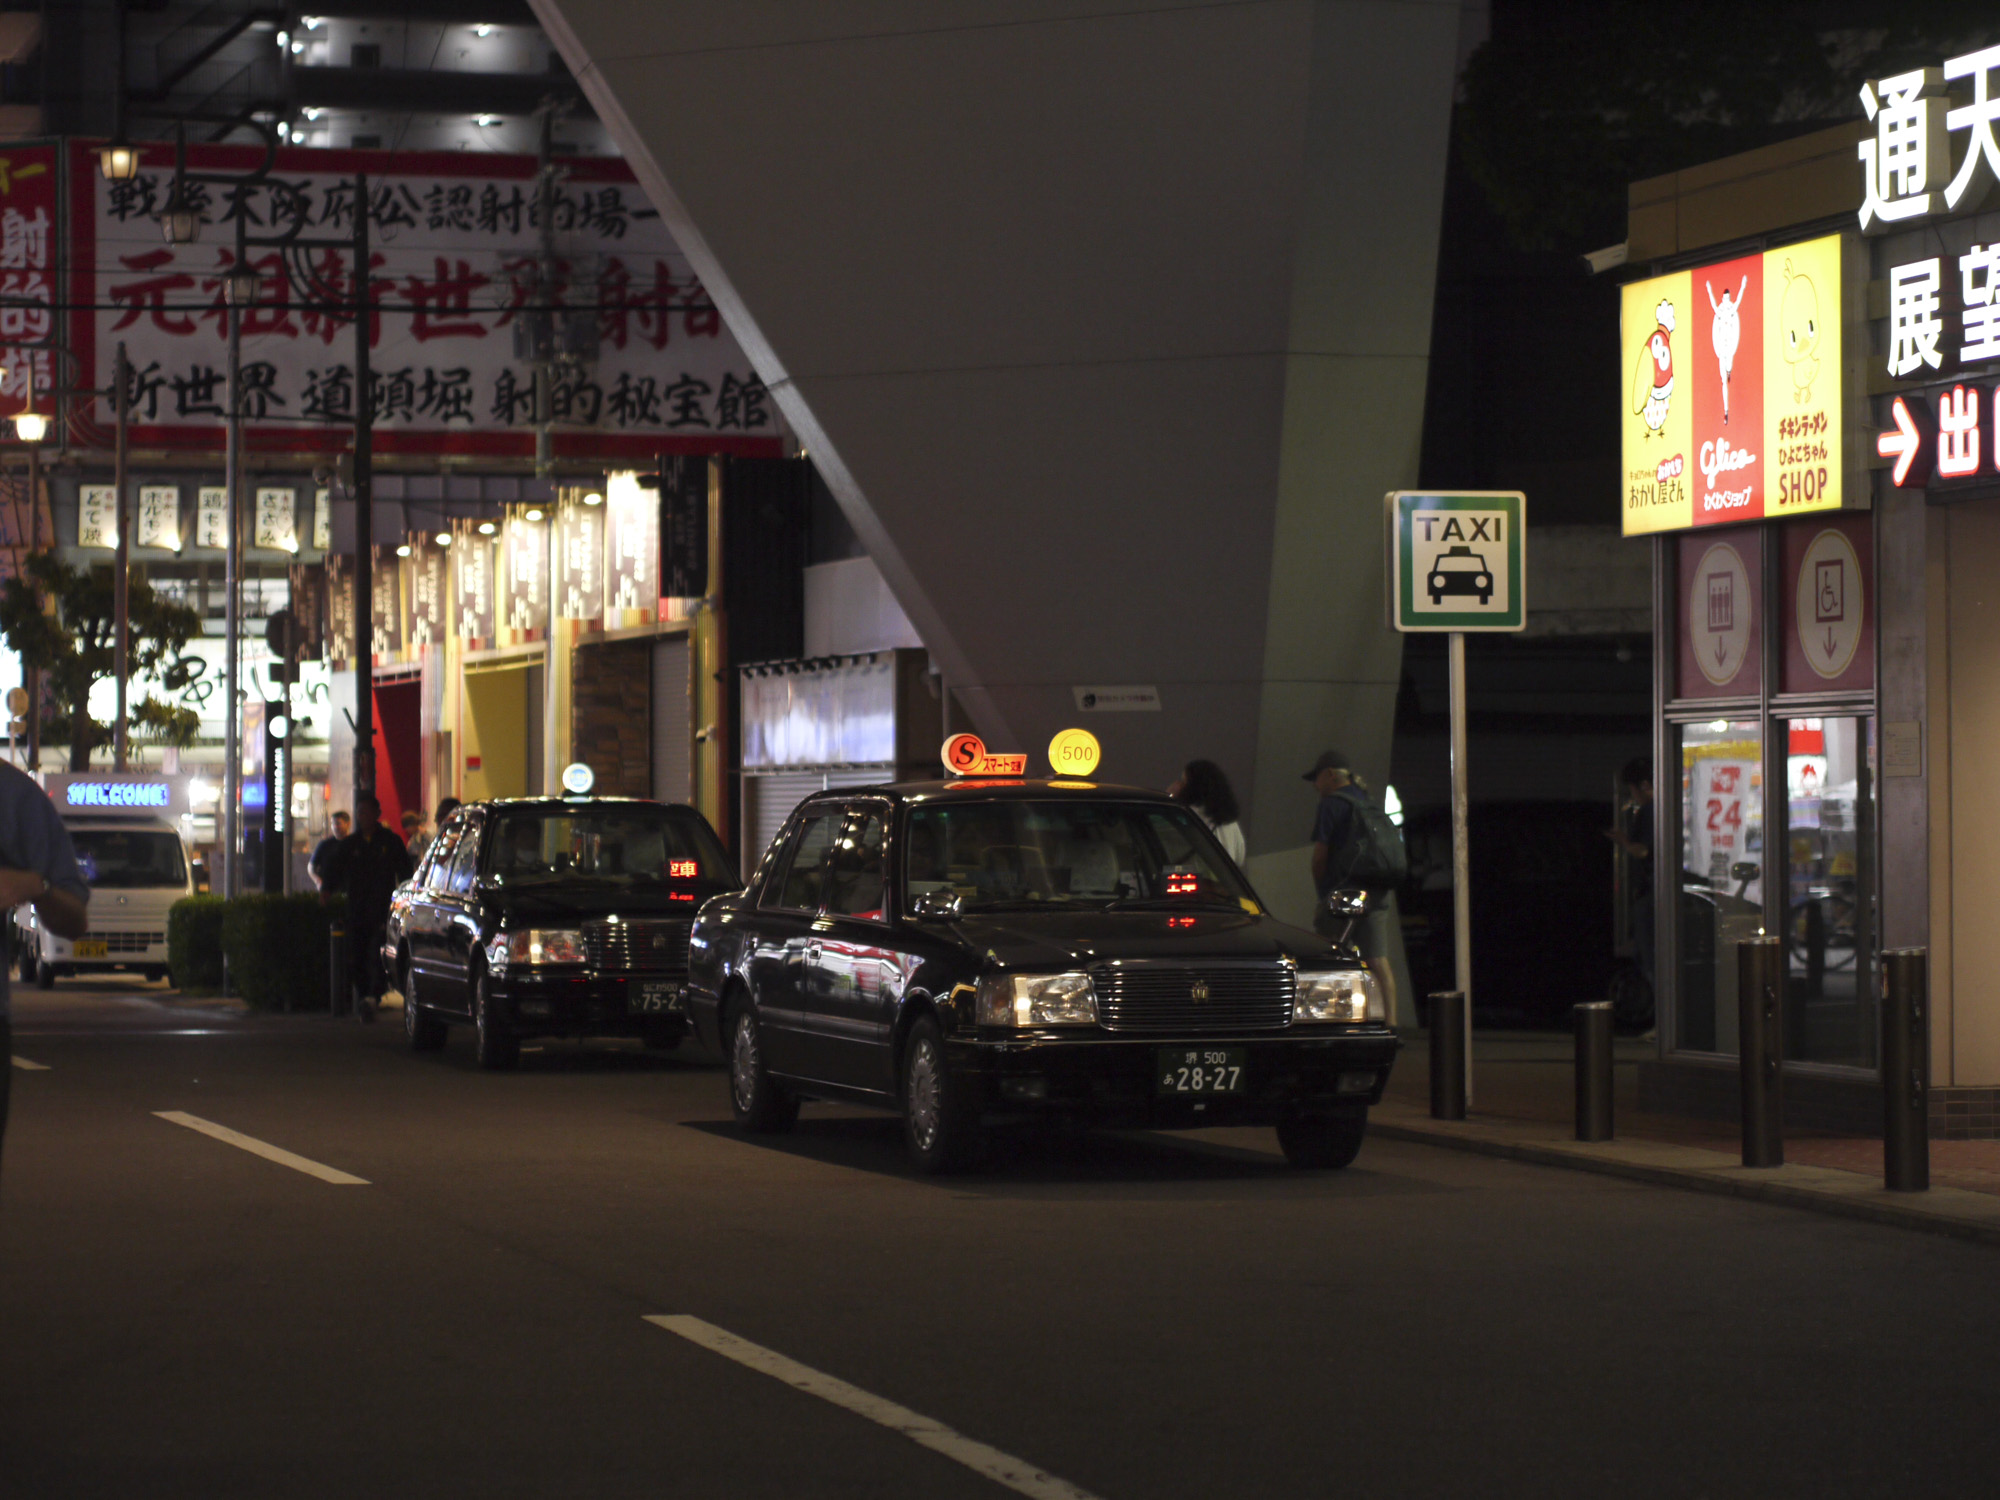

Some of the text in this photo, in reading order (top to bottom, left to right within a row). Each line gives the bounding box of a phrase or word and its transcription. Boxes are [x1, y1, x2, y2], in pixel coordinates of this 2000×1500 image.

[1779, 411, 1828, 441] チキンラーメン
[1937, 384, 2000, 478] 出
[1778, 441, 1828, 466] ひよこちゃん
[1629, 480, 1684, 509] おかし屋さん
[1703, 486, 1752, 511] わくわくショップ
[1779, 467, 1828, 505] SHOP
[1416, 517, 1501, 541] TAXI
[956, 741, 977, 764] S
[1062, 746, 1093, 761] 500
[641, 993, 684, 1010] 75-2
[1204, 1052, 1226, 1064] 500
[1163, 1066, 1240, 1091] あ 28-27
